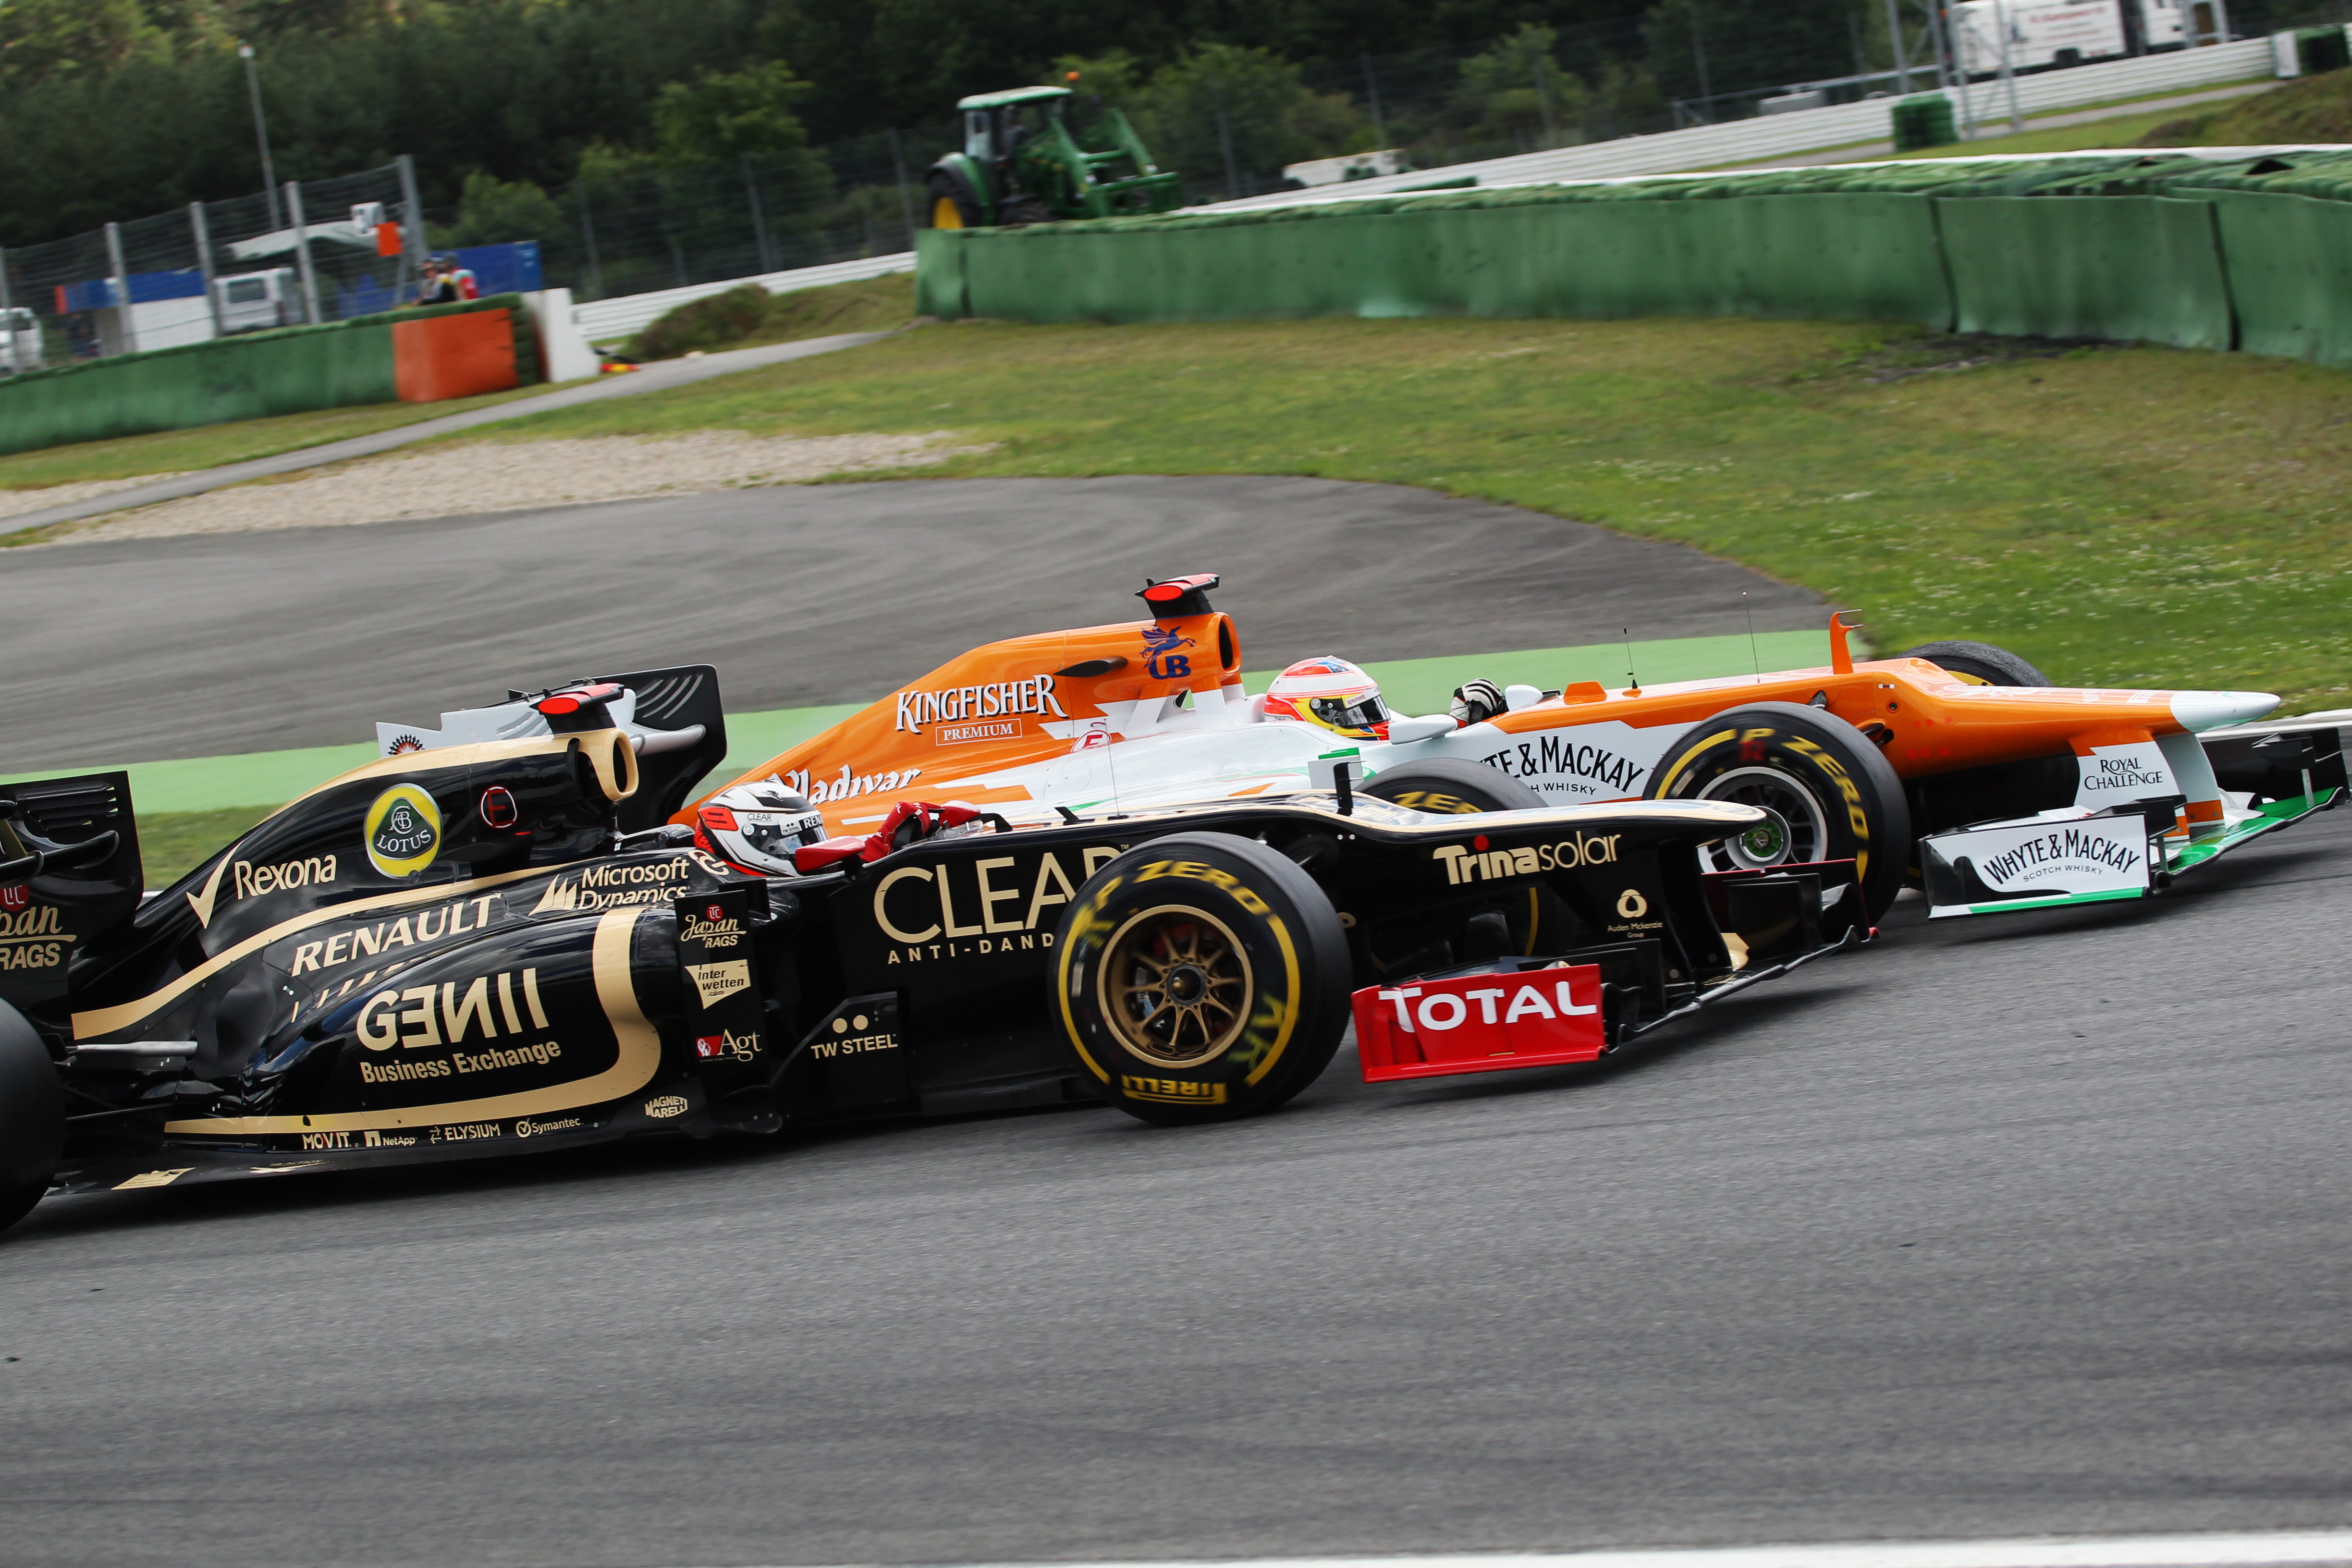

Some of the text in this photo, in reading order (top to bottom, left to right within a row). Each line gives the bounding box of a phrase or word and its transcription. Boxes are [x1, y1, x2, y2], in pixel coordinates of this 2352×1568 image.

[894, 674, 1068, 734] KINGFISHER
[943, 723, 1014, 742] PREMIUM
[1540, 735, 1645, 793] MACKAY
[2100, 758, 2142, 774] ROYAL
[1544, 782, 1597, 796] WHISKY
[1781, 735, 1869, 841] ZERO
[2084, 772, 2163, 790] CHALLENGE
[377, 829, 431, 852] LOTUS
[1983, 838, 2048, 885] WHYTE
[2065, 829, 2141, 874] MACKAY
[235, 855, 337, 899] Rexona
[581, 857, 690, 888] Microsoft
[2023, 865, 2104, 882] SCOTCH WHISKY
[578, 885, 687, 910] Dynamics
[1133, 860, 1272, 915] ZERO
[291, 893, 502, 977] RENAULT
[680, 914, 740, 942] Japan
[705, 935, 738, 948] RAGS
[698, 965, 726, 980] inter
[702, 978, 744, 991] wetten
[1378, 980, 1597, 1033] TOTAL
[717, 1029, 762, 1062] Agt
[811, 1034, 897, 1059] TW STEEL
[360, 1039, 561, 1083] Business Exchange
[1121, 1074, 1229, 1105] PIRELLI
[445, 1123, 501, 1141] ELYSIUM
[532, 1118, 581, 1134] Symantec
[382, 1137, 416, 1146] NetApp
